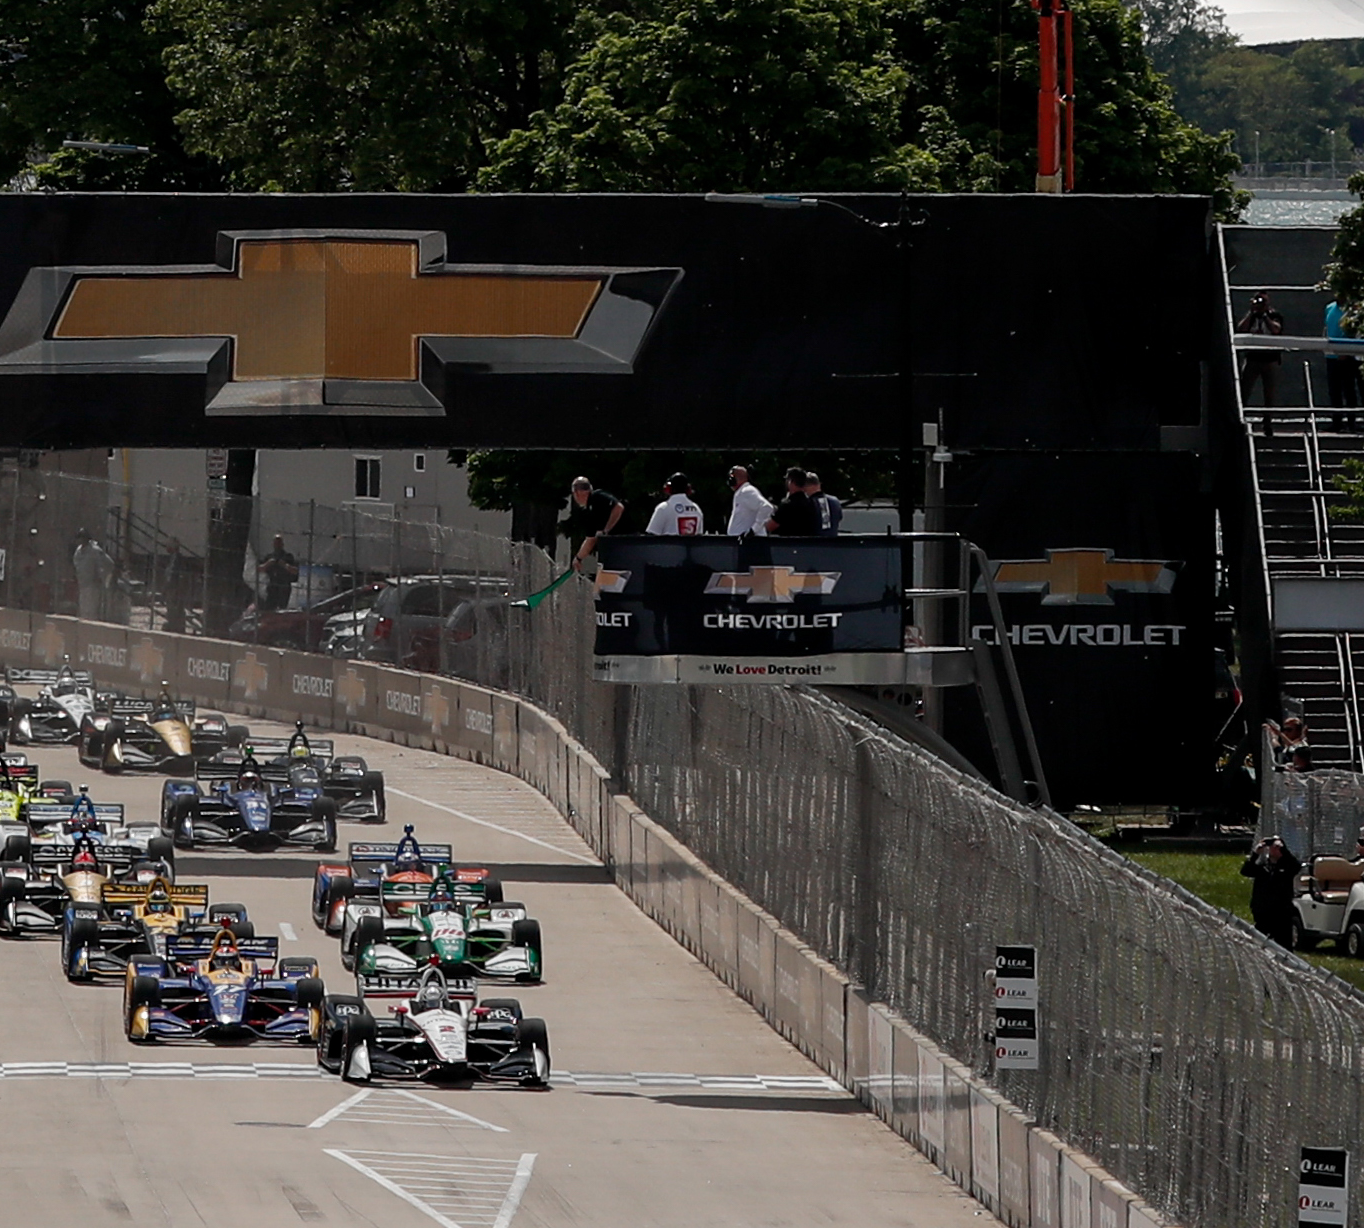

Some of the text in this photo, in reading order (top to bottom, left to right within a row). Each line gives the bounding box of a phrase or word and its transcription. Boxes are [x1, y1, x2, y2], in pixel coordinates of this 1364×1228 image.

[703, 612, 843, 629] CHEVROLET
[972, 624, 1187, 646] CHEVROLET
[187, 657, 231, 682] CHEVROLET
[713, 663, 822, 676] We Love Detroit!
[292, 674, 334, 698] CHEVROLET
[1007, 959, 1027, 967] LEAR
[365, 977, 468, 988] HITAHI
[1007, 989, 1027, 997] LEAR
[1007, 1019, 1028, 1027] LEAR
[1007, 1049, 1028, 1057] LEAR
[1313, 1163, 1336, 1172] LEAR
[1311, 1200, 1335, 1209] LEAR
